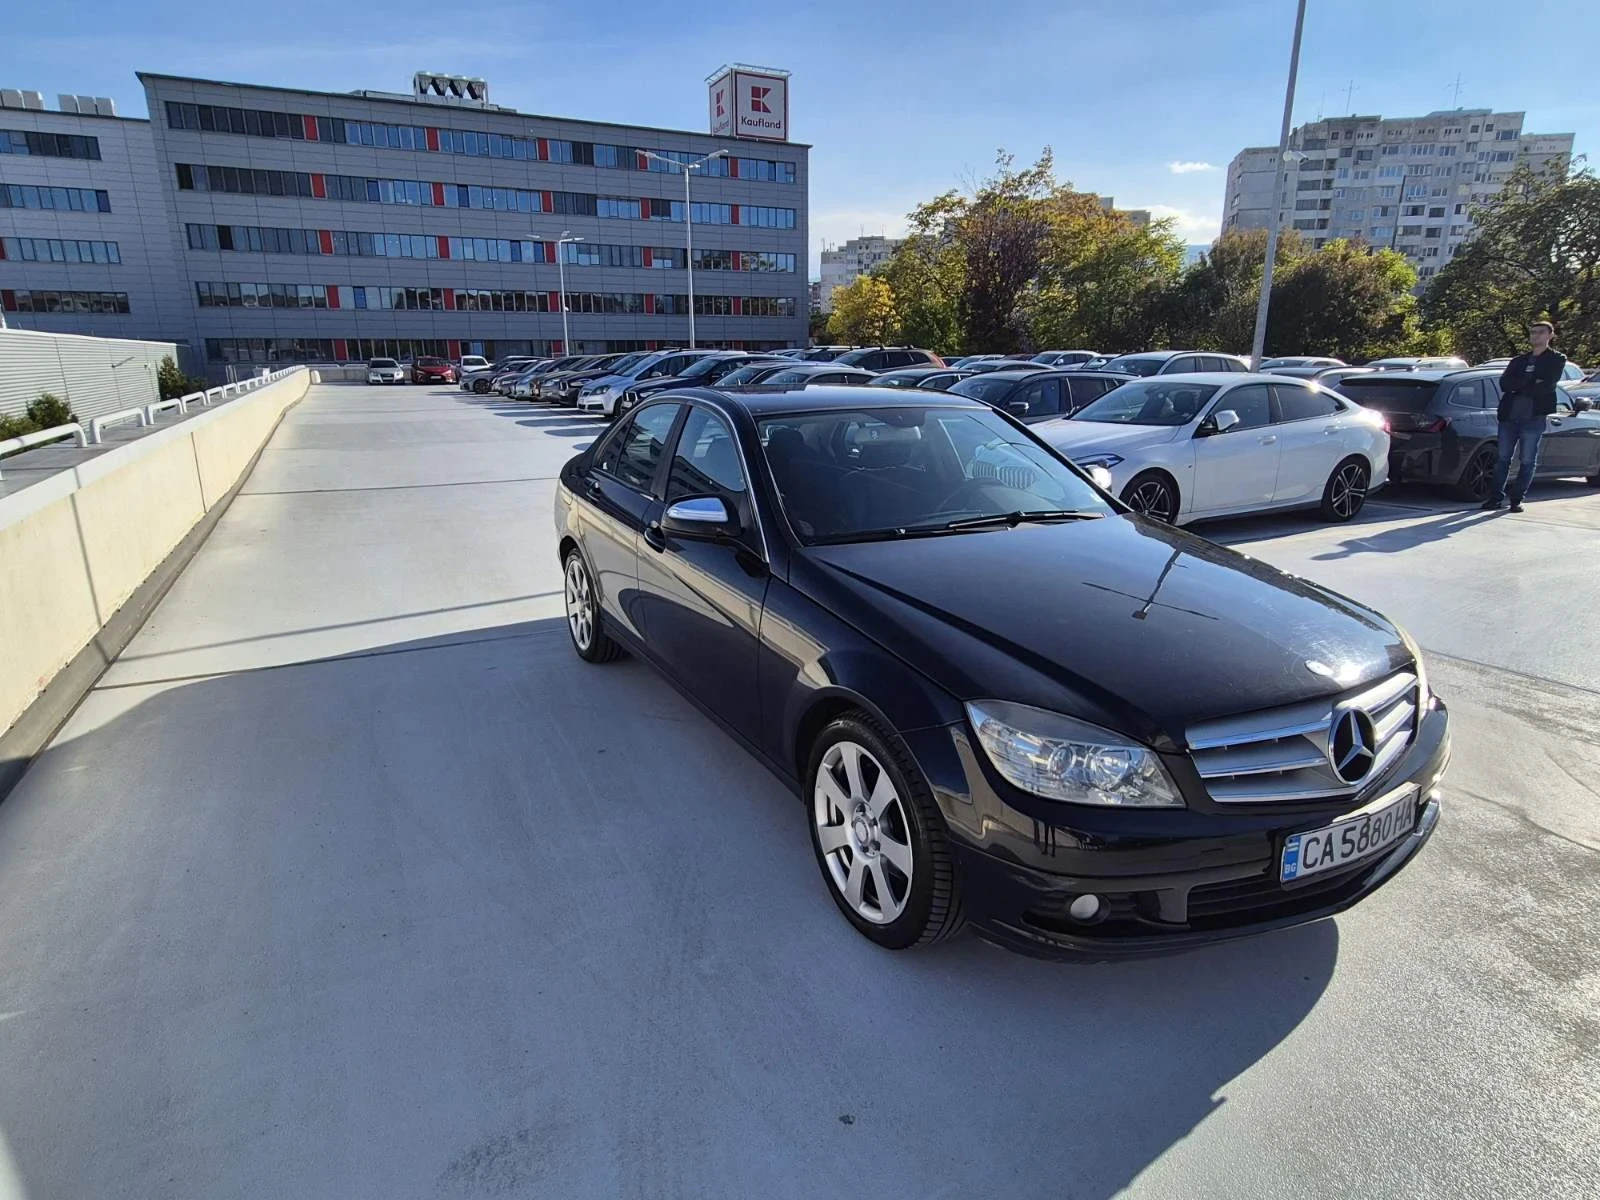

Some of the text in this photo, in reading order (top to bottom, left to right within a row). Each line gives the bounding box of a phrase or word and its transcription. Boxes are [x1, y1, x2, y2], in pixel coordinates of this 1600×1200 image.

[751, 86, 772, 113] K
[741, 116, 781, 129] Kaufland
[1302, 797, 1412, 869] CA 5880 HA
[1284, 862, 1297, 873] BG
